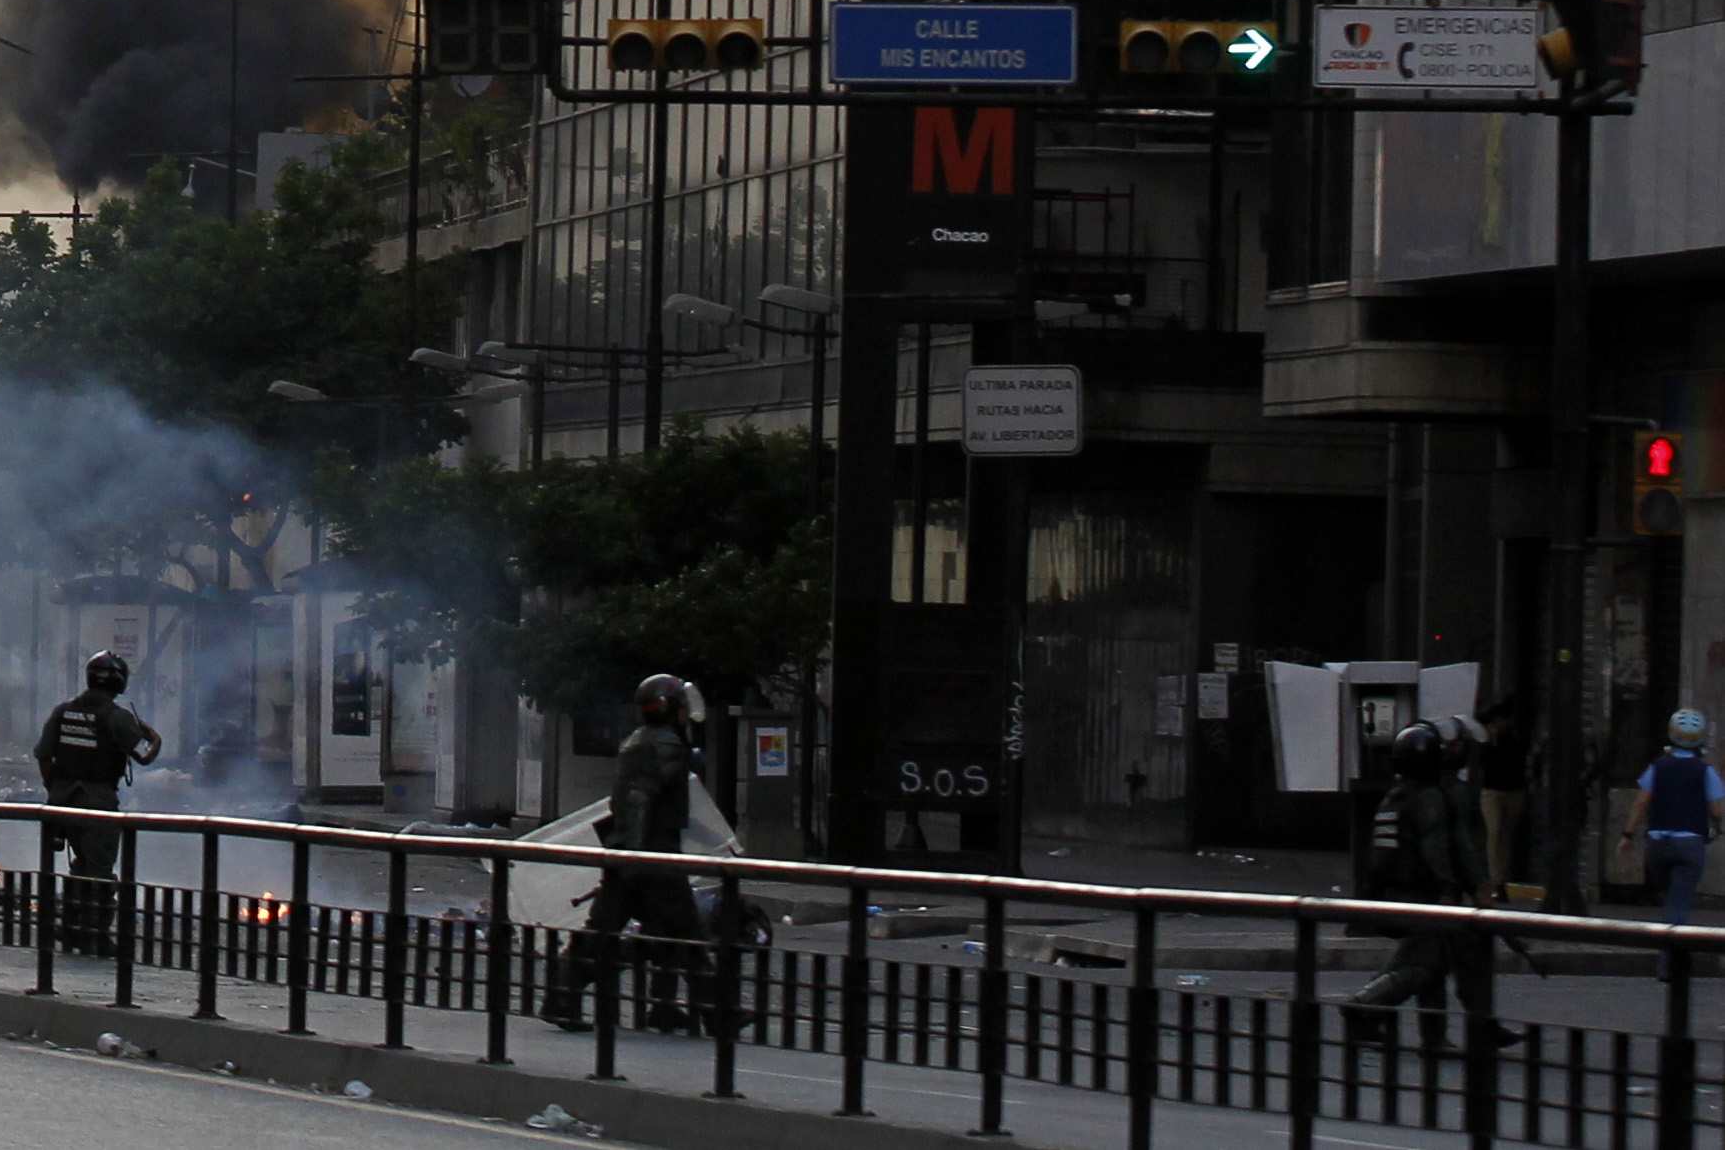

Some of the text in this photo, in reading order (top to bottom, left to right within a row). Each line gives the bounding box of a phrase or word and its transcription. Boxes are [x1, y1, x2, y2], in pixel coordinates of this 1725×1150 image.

[915, 19, 979, 38] CALLE
[1394, 17, 1532, 35] EMERGENCIAS
[880, 49, 1026, 69] MIS ENCANTOS
[913, 106, 1015, 194] M
[931, 227, 990, 243] Chacao
[969, 379, 1074, 391] ULTIMA PARADA
[977, 404, 1064, 416] RUTAS HACIA
[993, 430, 1075, 442] LIBERTADOR
